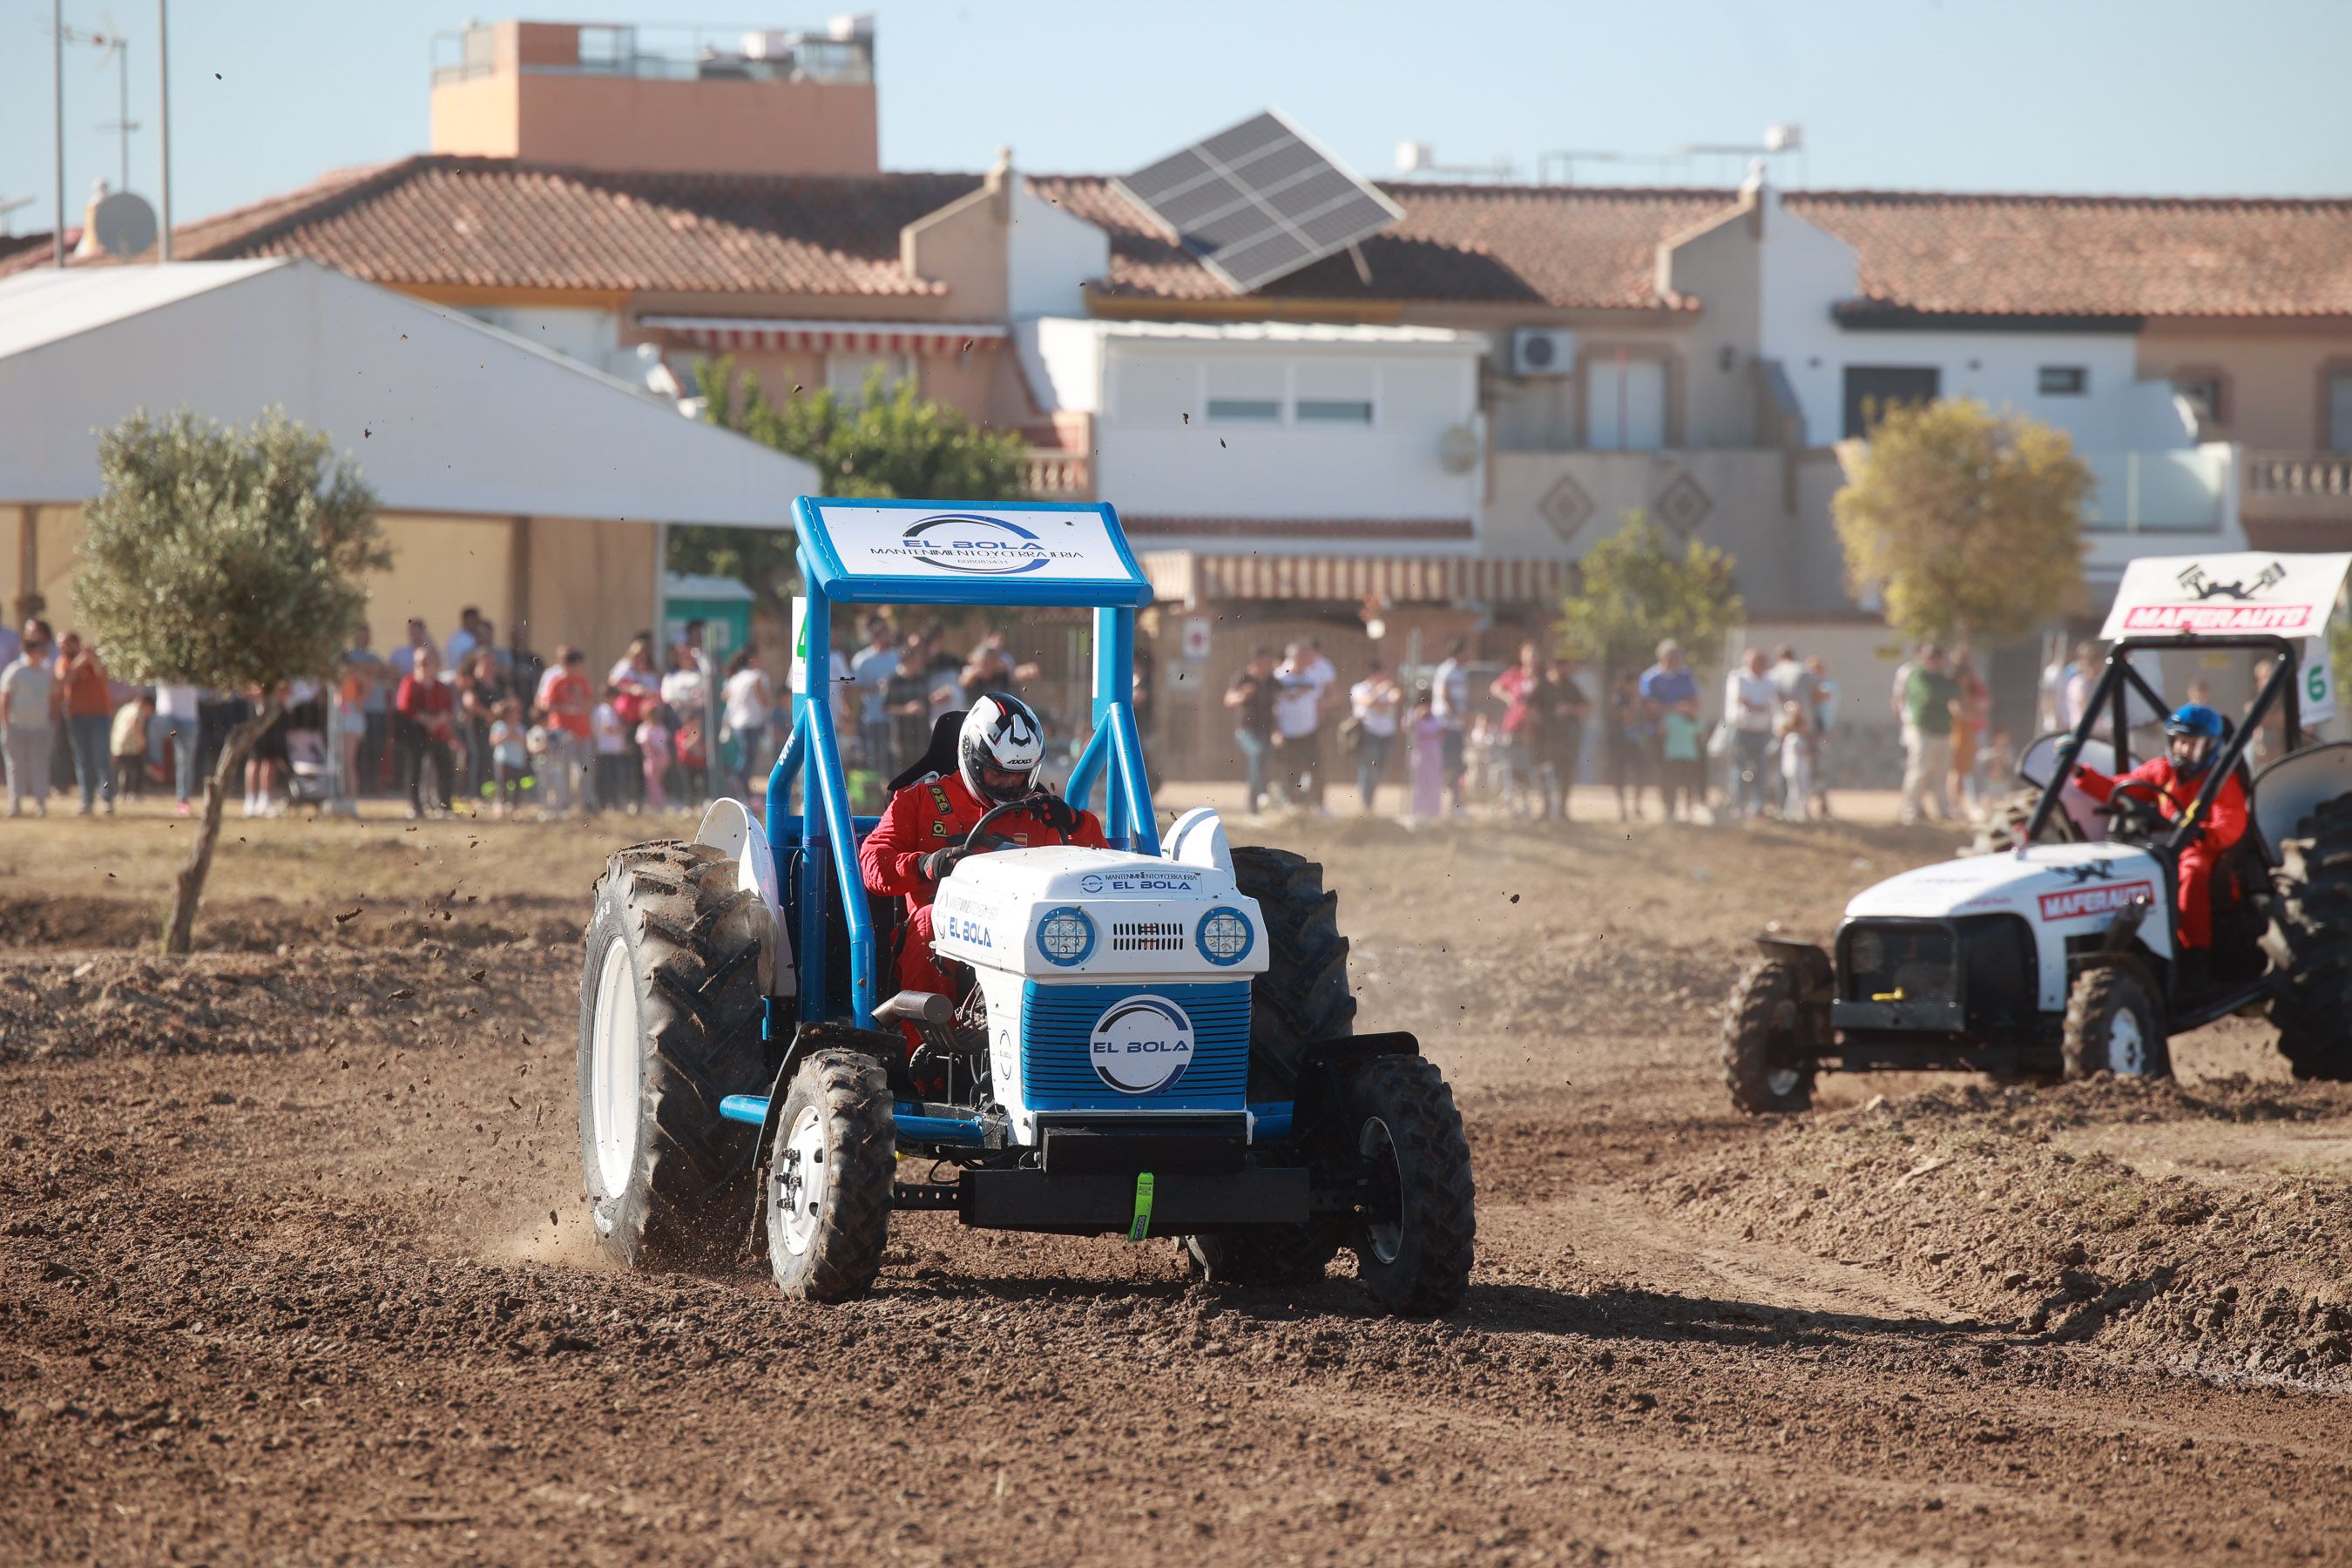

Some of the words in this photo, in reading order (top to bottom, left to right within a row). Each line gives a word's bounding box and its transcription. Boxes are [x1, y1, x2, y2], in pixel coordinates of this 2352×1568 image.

[952, 541, 1045, 550] BOLA
[2130, 608, 2309, 628] MAFERAUTO
[2307, 664, 2327, 702] 6
[950, 916, 960, 938] EL
[963, 921, 991, 948] BOLA
[1093, 1042, 1119, 1053] EL
[1126, 1040, 1189, 1053] BOLA
